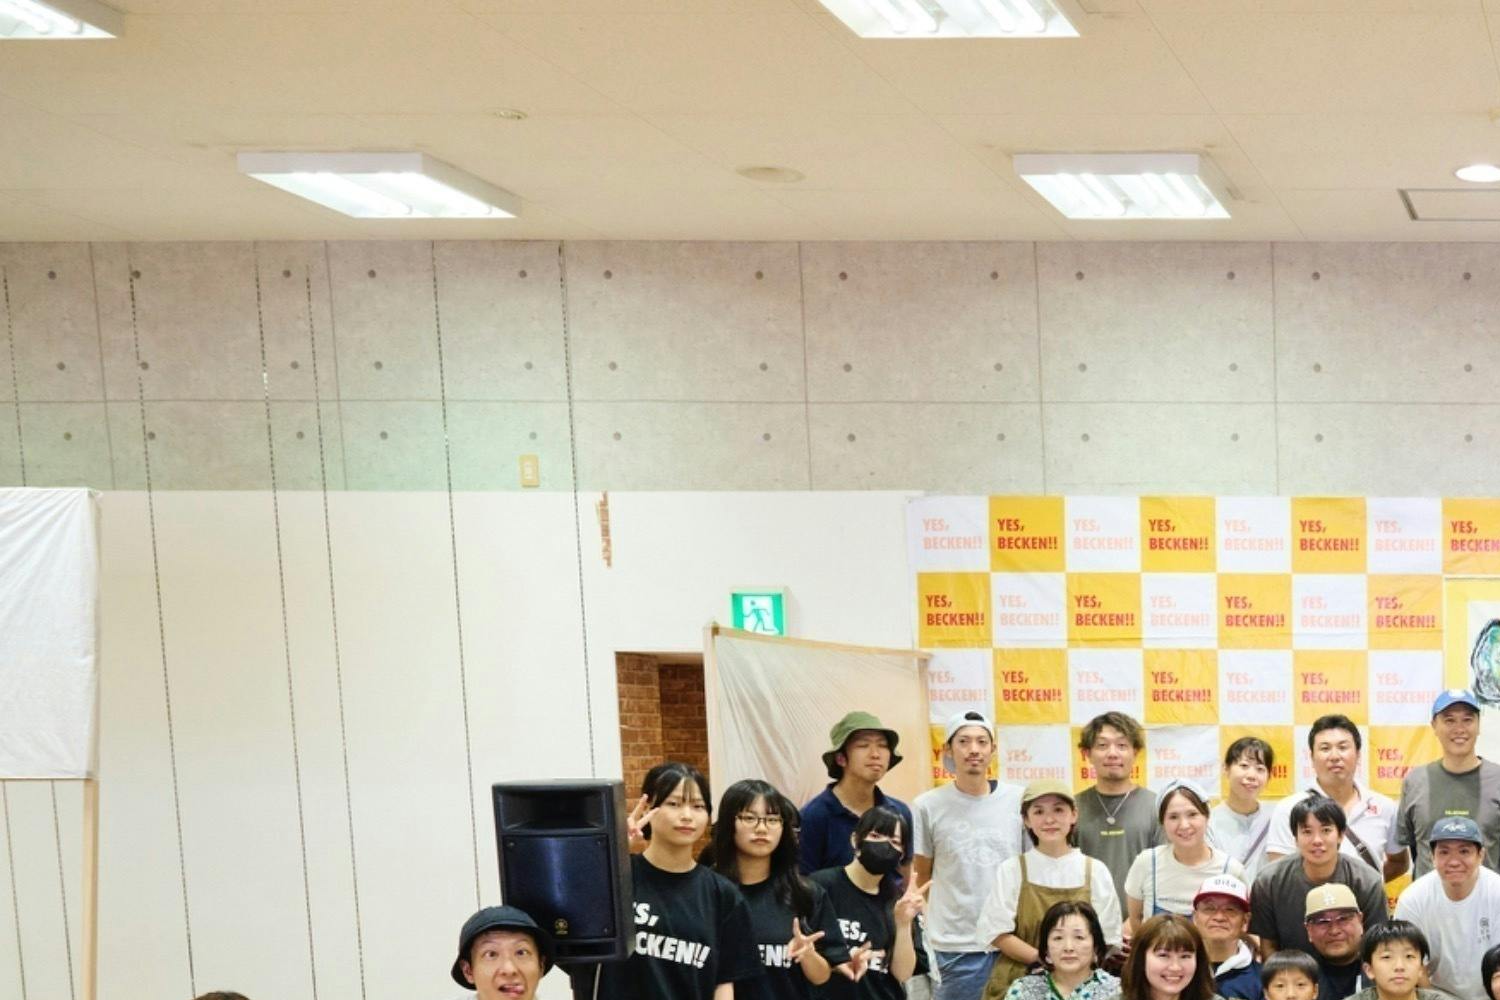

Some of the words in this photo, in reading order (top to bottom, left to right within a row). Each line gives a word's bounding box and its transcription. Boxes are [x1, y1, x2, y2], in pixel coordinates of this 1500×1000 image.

[996, 517, 1022, 532] YES,
[1149, 518, 1175, 532] YES,
[1299, 520, 1324, 533] YES,
[1451, 520, 1477, 534] YES,
[997, 536, 1056, 549] BECKEN!!
[1148, 536, 1206, 551] BECKEN!!
[1299, 538, 1357, 551] BECKEN!!
[926, 593, 952, 607] YES,
[1076, 594, 1102, 608] YES,
[1225, 596, 1250, 609] YES,
[1376, 596, 1402, 612] YES,
[925, 612, 982, 626] BECKEN!!
[1075, 613, 1133, 626] BECKEN!!
[1225, 614, 1285, 627] BECKEN!!
[1376, 615, 1433, 628] BECKEN!!
[1001, 671, 1027, 685] YES,
[1152, 672, 1177, 685] YES,
[1301, 672, 1327, 686] YES,
[1002, 688, 1061, 703] BECKEN!!
[1152, 688, 1210, 702] BECKEN!!
[1301, 690, 1360, 704] BECKEN!!
[1377, 748, 1403, 761] YES,
[635, 931, 711, 969] CKEN!!
